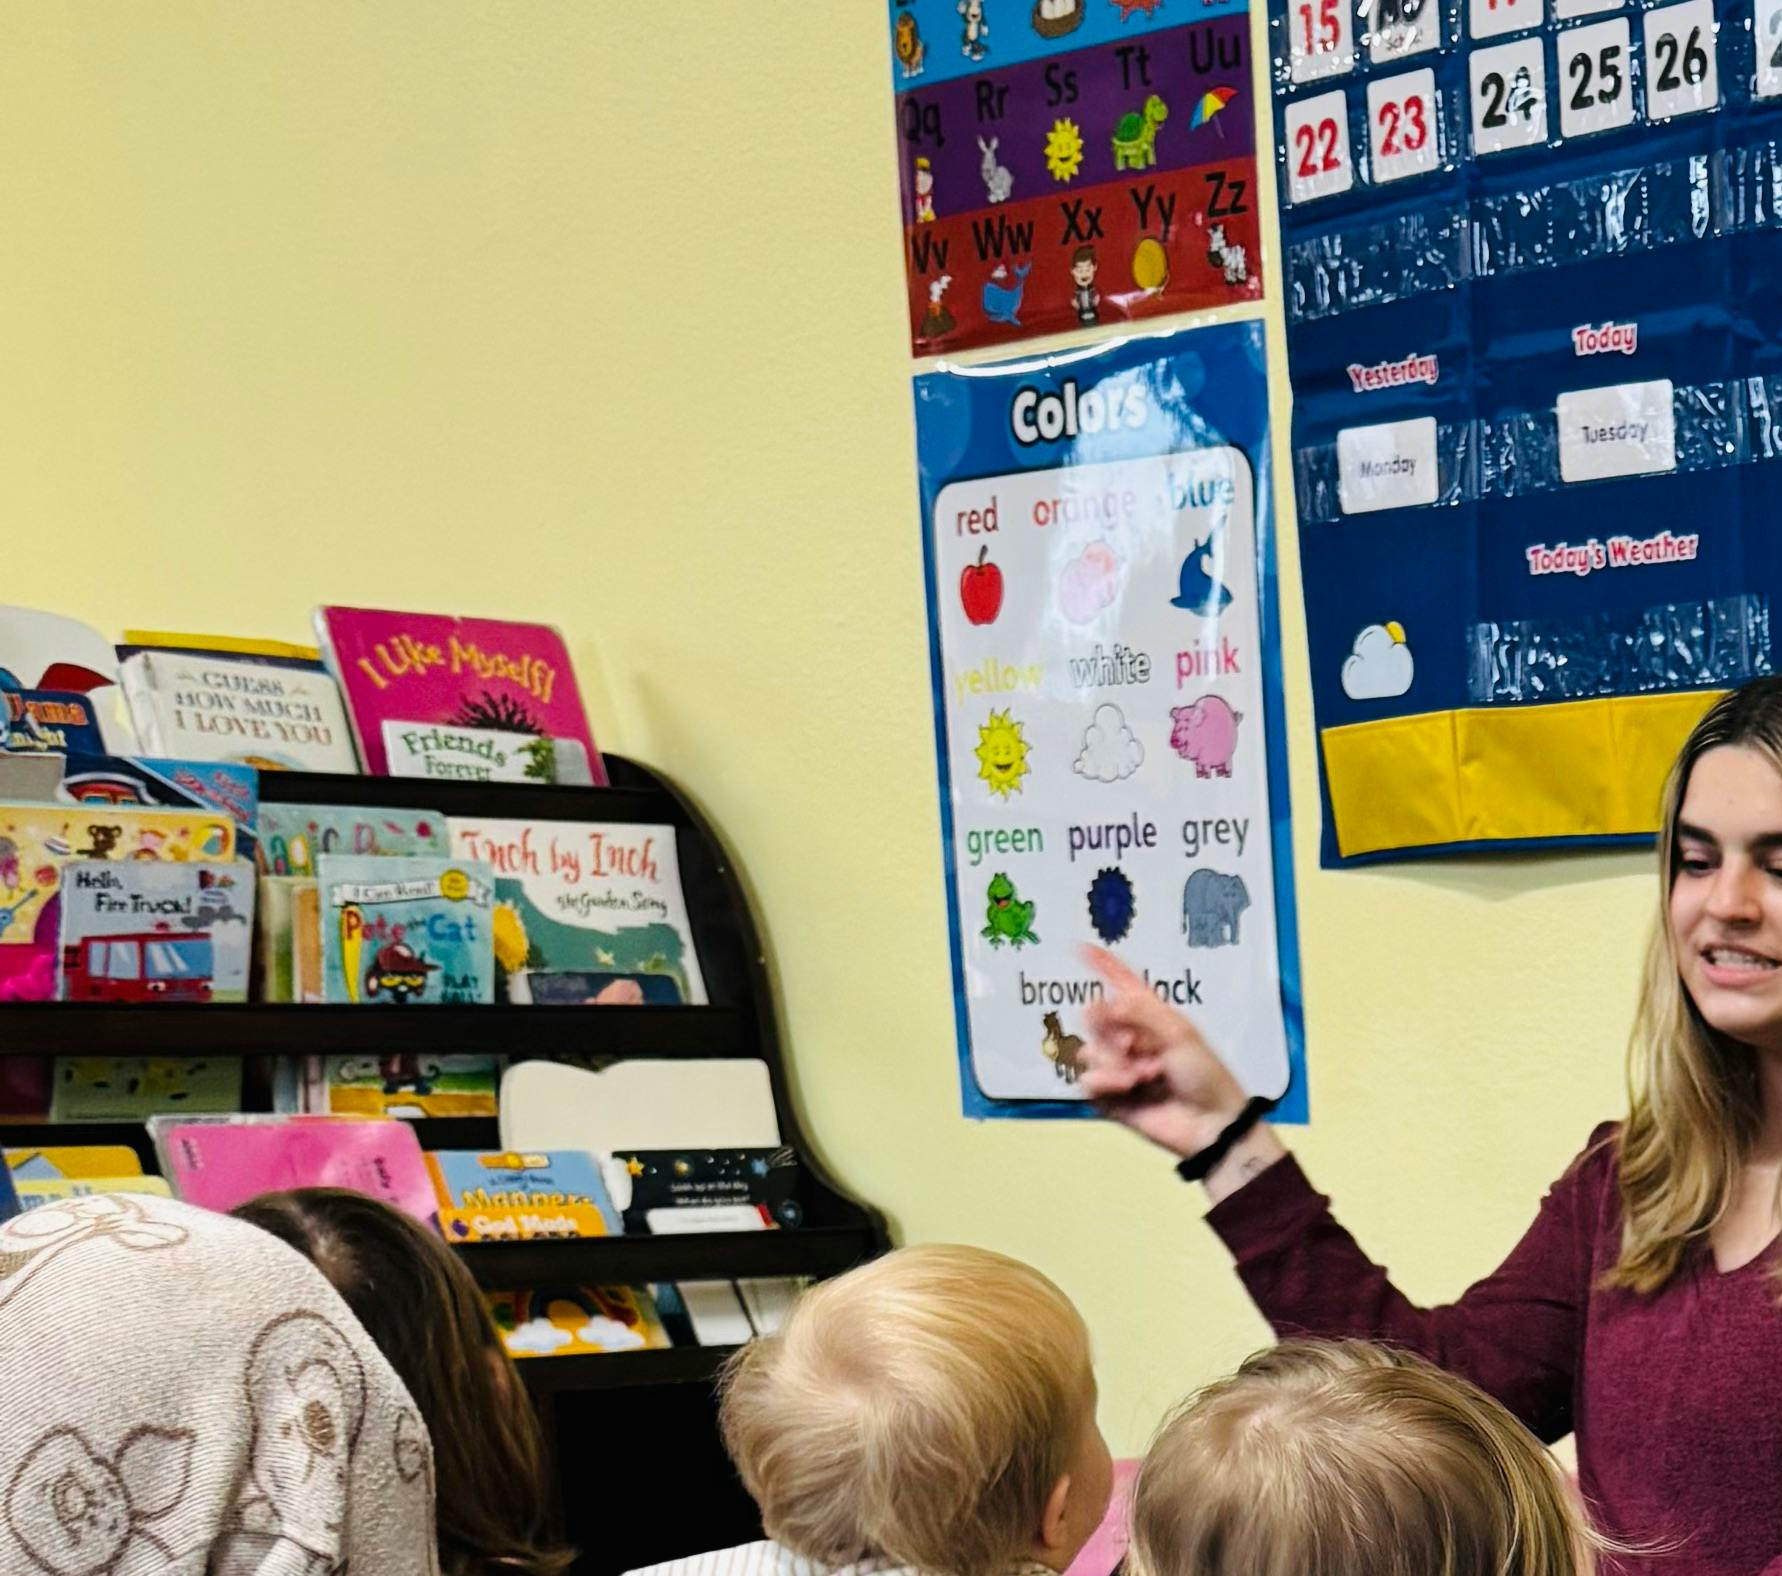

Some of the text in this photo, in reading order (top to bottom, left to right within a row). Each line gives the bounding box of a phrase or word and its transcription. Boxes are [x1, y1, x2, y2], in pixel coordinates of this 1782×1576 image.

[1300, 0, 1341, 55] 15
[904, 29, 1241, 148] Qq Rr Ss Tt Uu
[1296, 25, 1709, 177] 22 23 24 25 26
[911, 171, 1248, 274] Vv Ww Xx Yy Zz
[1572, 322, 1638, 356] Today
[1347, 353, 1439, 392] Yesterday
[1012, 378, 1150, 447] Colors
[1582, 420, 1649, 444] Tuesday
[1360, 456, 1416, 479] Monday
[957, 470, 1235, 536] red orange blue
[1526, 530, 1699, 576] Today's Weather
[202, 671, 285, 696] GUESS
[357, 633, 556, 704] I Like Myself!
[955, 636, 1240, 704] yellow white pink
[175, 691, 322, 722] HOW MUCH
[175, 709, 333, 746] I LOVE YOU
[401, 728, 507, 768] Friends
[424, 754, 492, 781] Forever
[550, 836, 582, 885] by
[589, 831, 660, 884] Inch
[967, 812, 1249, 865] green purple grey
[95, 892, 193, 914] Fire Truck!
[345, 910, 407, 942] Pete
[427, 913, 477, 942] Cat
[1020, 968, 1203, 1006] brown lack
